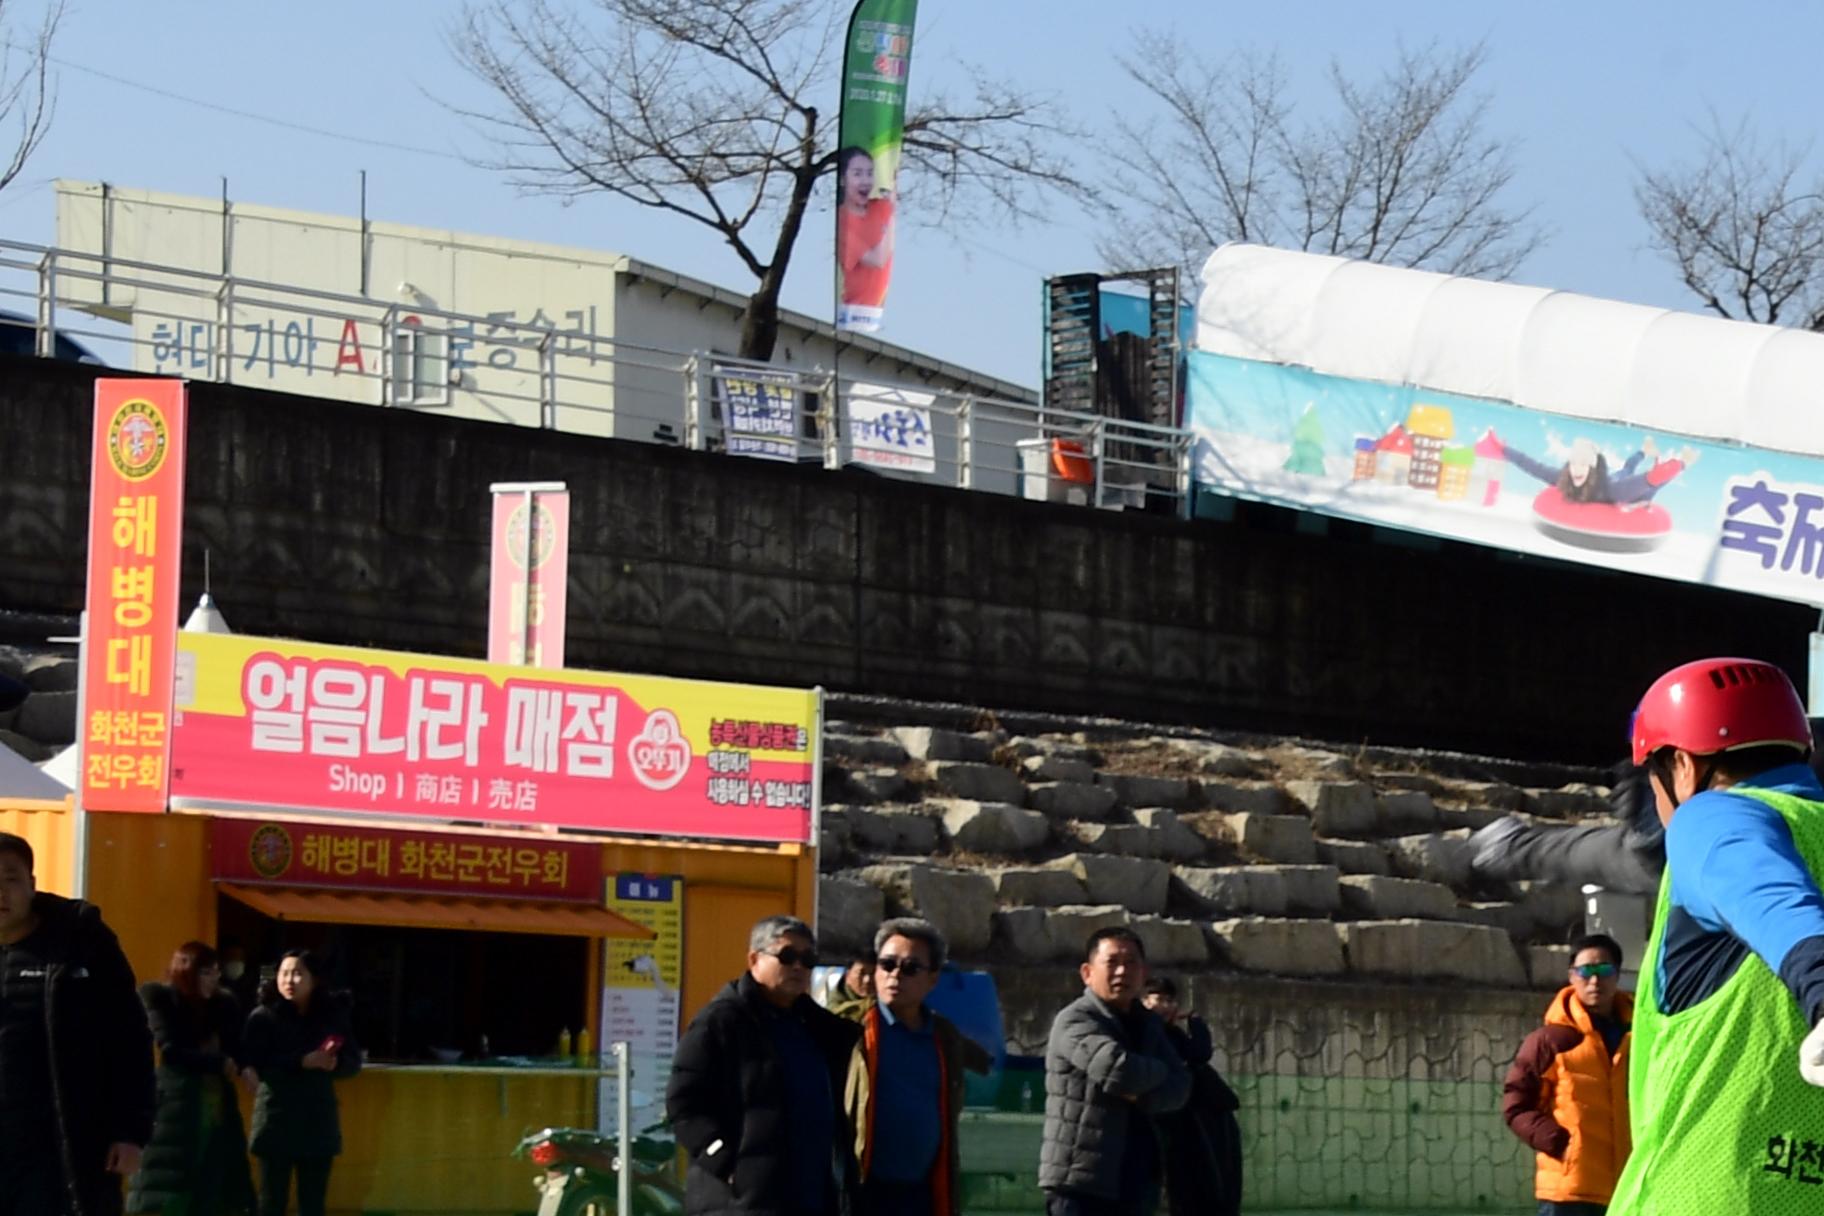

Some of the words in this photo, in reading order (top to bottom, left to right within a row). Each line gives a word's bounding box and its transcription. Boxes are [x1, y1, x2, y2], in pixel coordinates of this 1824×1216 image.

[243, 317, 317, 379] 기아
[106, 495, 157, 697] 해병대
[89, 709, 166, 747] 화천군
[247, 660, 489, 768] 얼음나라
[504, 686, 619, 779] 매점
[87, 753, 164, 790] 전우회
[637, 747, 682, 772] 오뚜기
[328, 763, 386, 801] Shop
[415, 772, 463, 805] 商店
[751, 779, 764, 807] 수
[301, 834, 391, 876] 해병대
